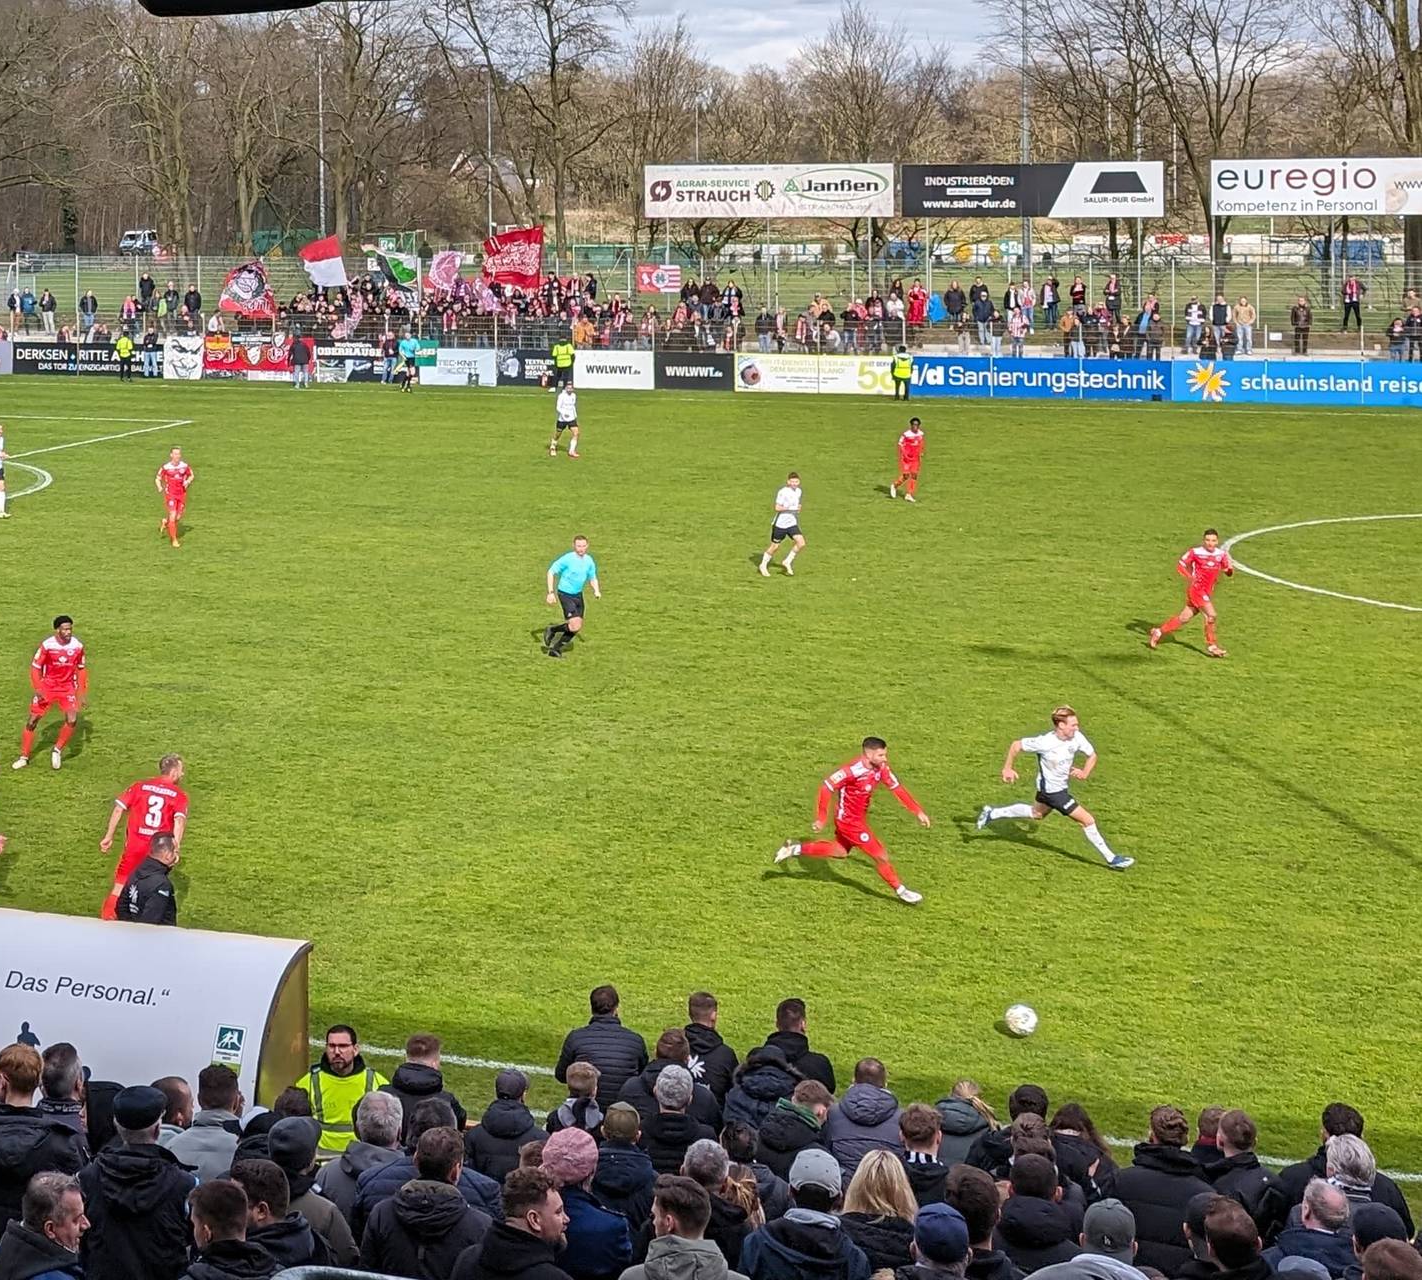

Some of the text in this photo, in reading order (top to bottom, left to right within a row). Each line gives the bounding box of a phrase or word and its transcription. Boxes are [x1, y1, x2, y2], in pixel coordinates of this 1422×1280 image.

[676, 179, 750, 188] AGRAR-SERVICE
[801, 179, 879, 193] Janßen
[924, 175, 1015, 187] INDUSTRIEBÖDEN
[1216, 161, 1377, 197] euregio
[675, 189, 751, 203] STRAUCH
[1083, 196, 1129, 204] SALUR-DUR
[923, 198, 1016, 210] www.salur-dur.de
[1216, 199, 1378, 214] Kompetenz in Personal
[16, 348, 68, 361] DERKSEN
[78, 350, 110, 362] RITTE
[586, 365, 641, 376] WWLWWT.de
[665, 366, 724, 378] WWLWWT.de
[948, 365, 1166, 393] Sanierungstechnik
[1241, 373, 1374, 393] schauinsland
[144, 794, 165, 828] 3
[5, 970, 48, 993] Das
